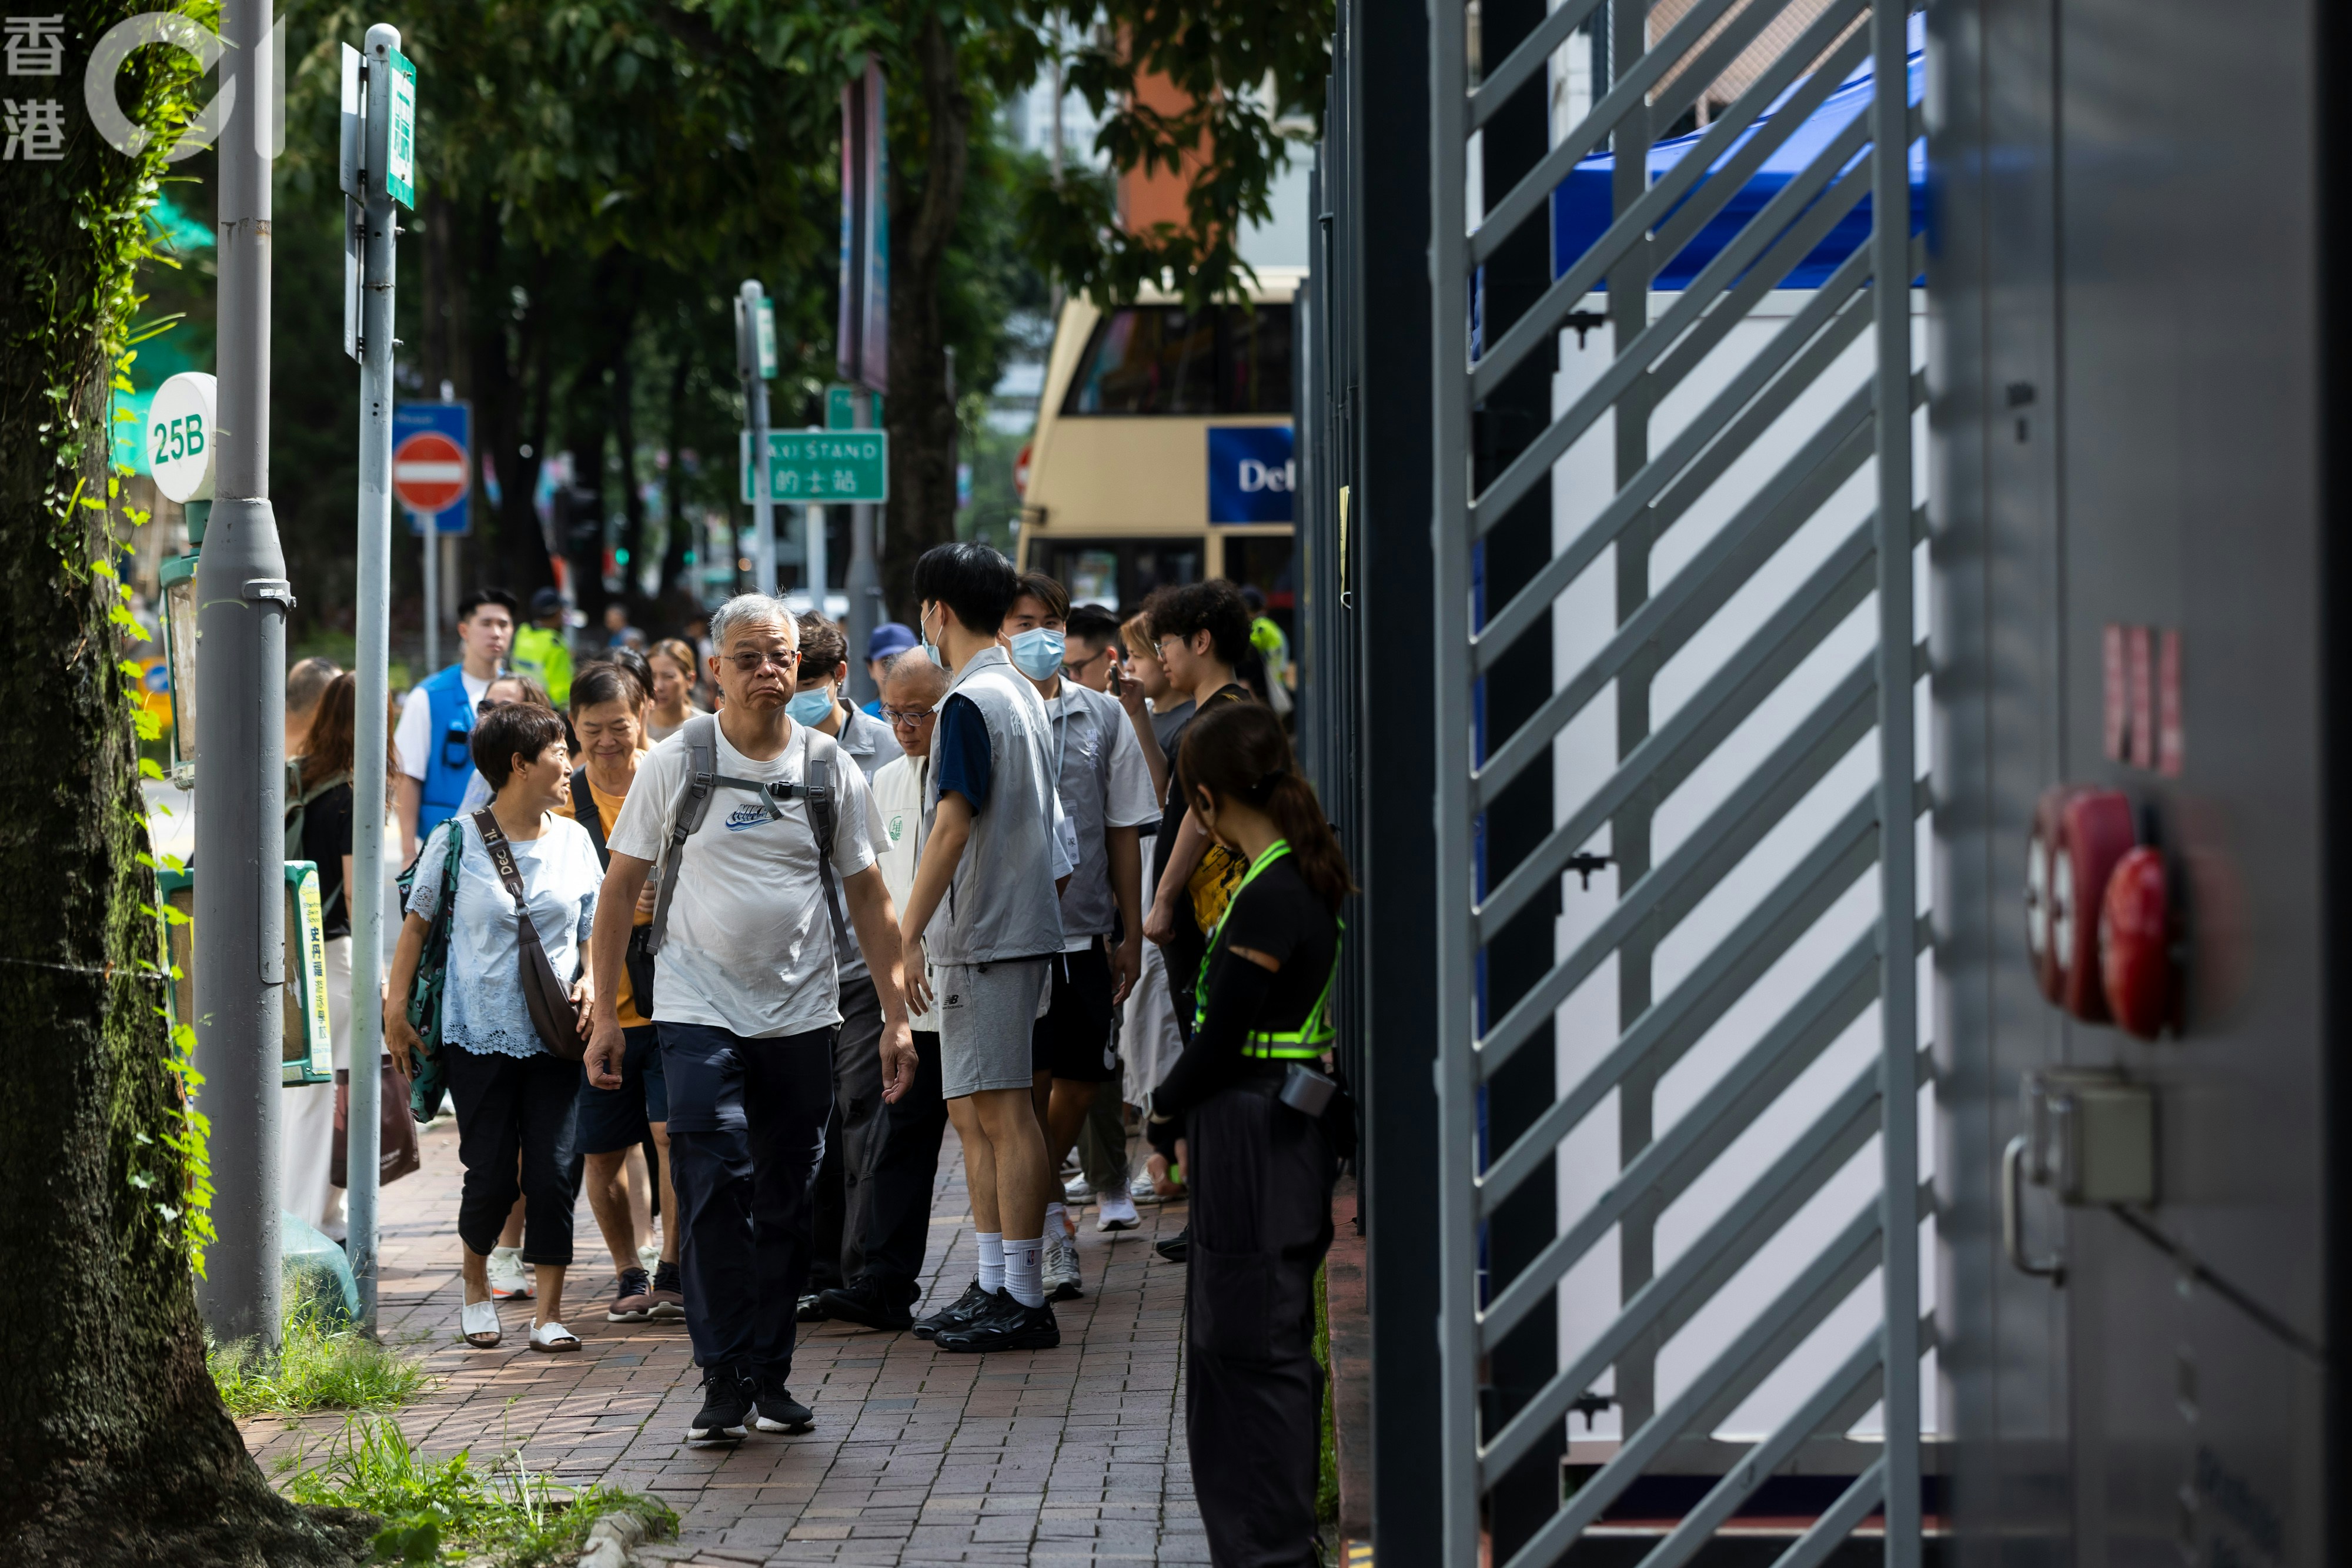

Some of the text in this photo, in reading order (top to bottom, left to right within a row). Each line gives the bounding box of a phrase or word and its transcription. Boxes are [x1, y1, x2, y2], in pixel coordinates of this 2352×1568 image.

[154, 414, 204, 465] 25B
[769, 443, 877, 459] AXI STAND
[776, 470, 858, 493] 的士站
